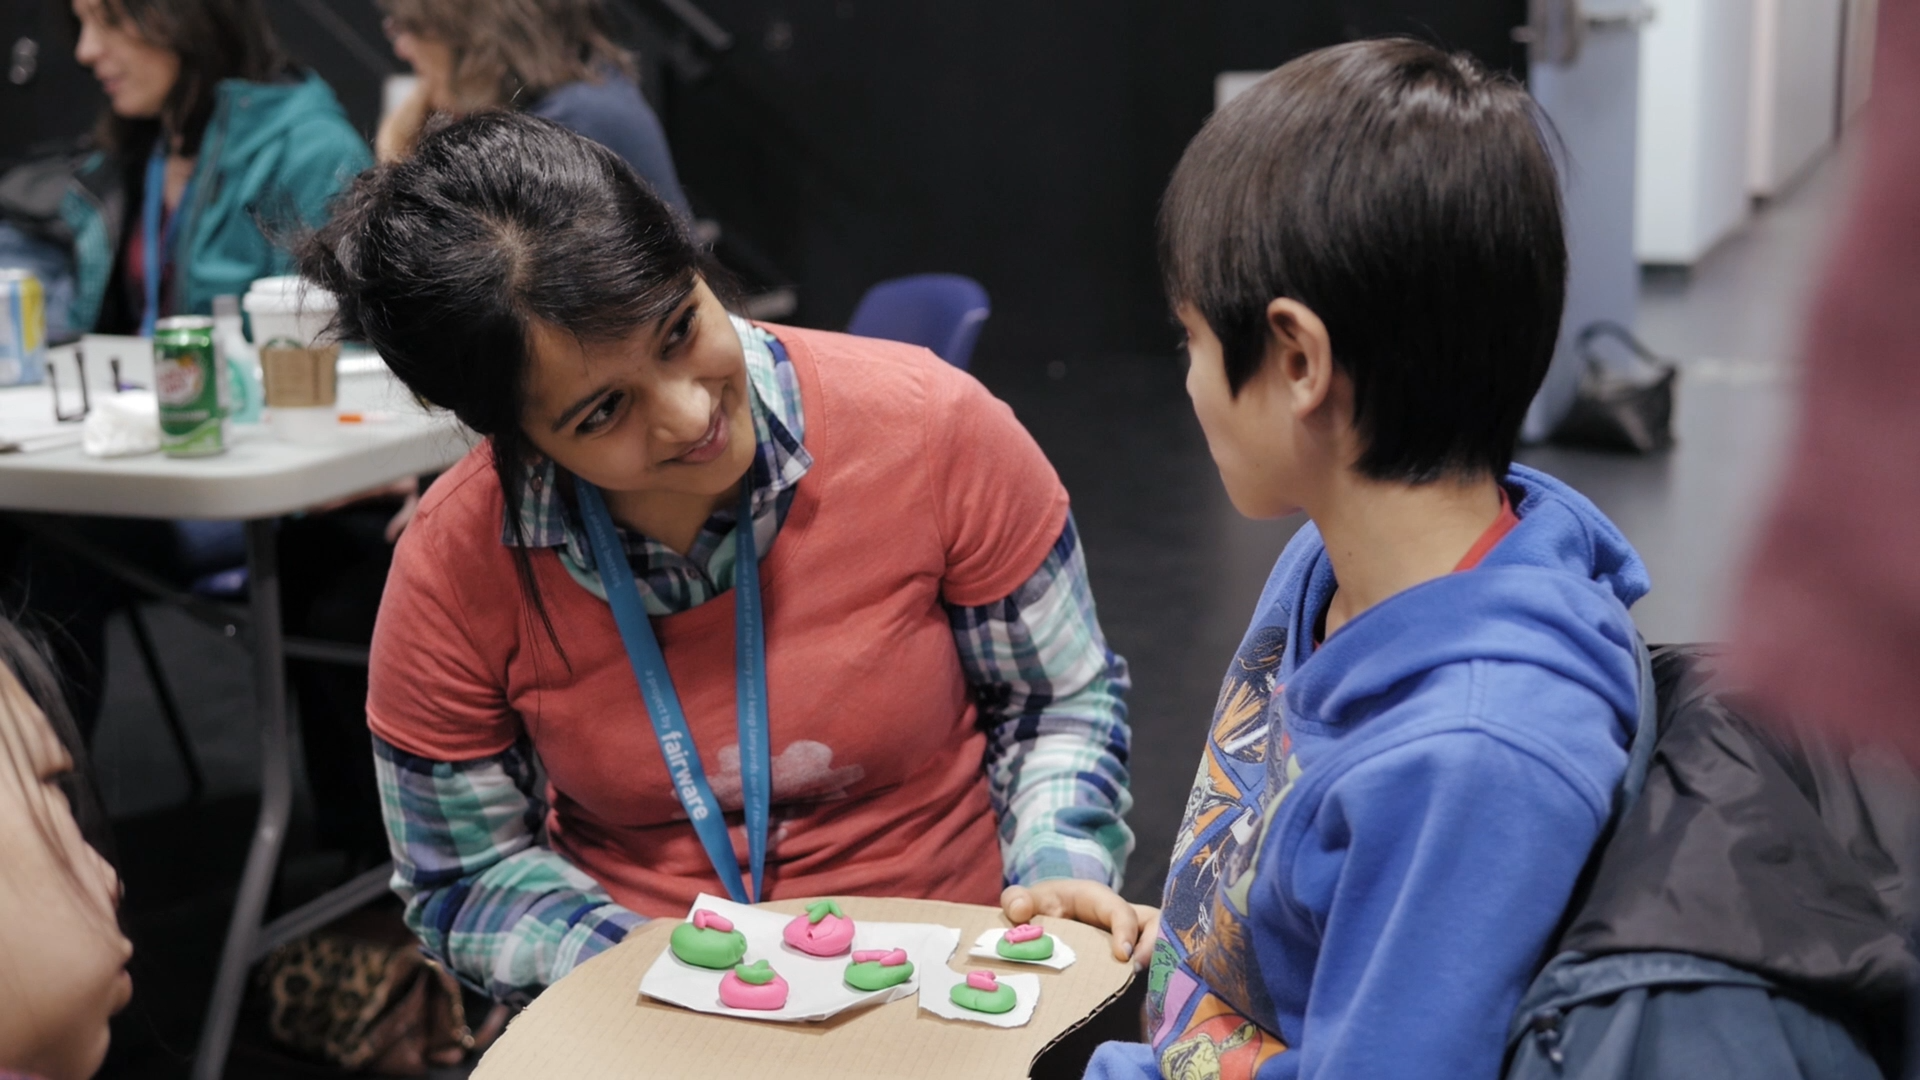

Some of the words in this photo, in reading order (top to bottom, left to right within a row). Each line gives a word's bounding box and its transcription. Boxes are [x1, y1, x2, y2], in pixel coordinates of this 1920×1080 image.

[743, 587, 752, 610] part
[744, 611, 754, 625] of
[744, 626, 754, 645] the
[744, 646, 754, 676] story
[647, 677, 668, 715] project
[746, 678, 757, 699] and
[661, 715, 672, 730] by
[746, 700, 758, 727] keep
[747, 728, 760, 774] lanyards
[661, 731, 709, 820] fairware
[750, 776, 759, 794] out
[752, 810, 761, 828] the
